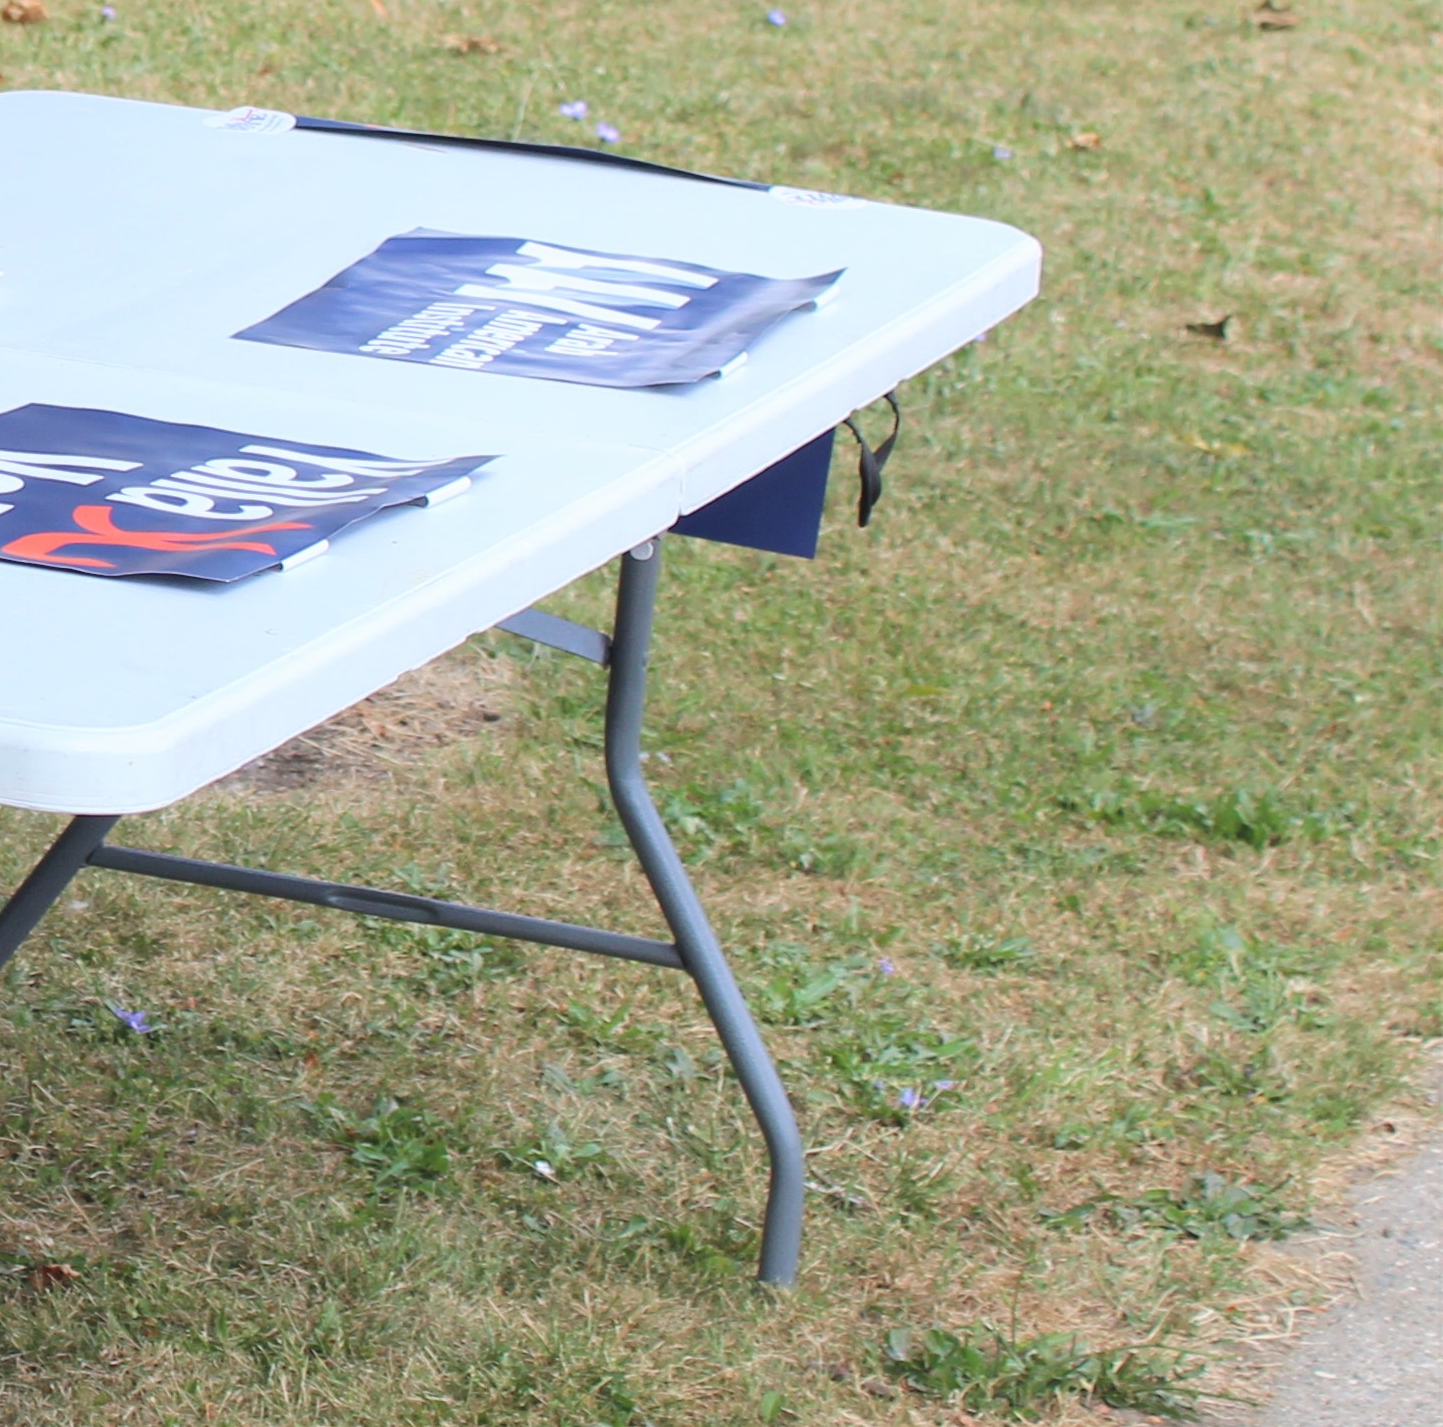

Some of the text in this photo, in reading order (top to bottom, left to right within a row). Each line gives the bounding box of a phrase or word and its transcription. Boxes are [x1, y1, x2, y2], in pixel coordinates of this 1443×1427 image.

[358, 302, 497, 356] Institute
[428, 308, 568, 370] American
[544, 322, 640, 358] Arab
[109, 445, 470, 521] Yalla
